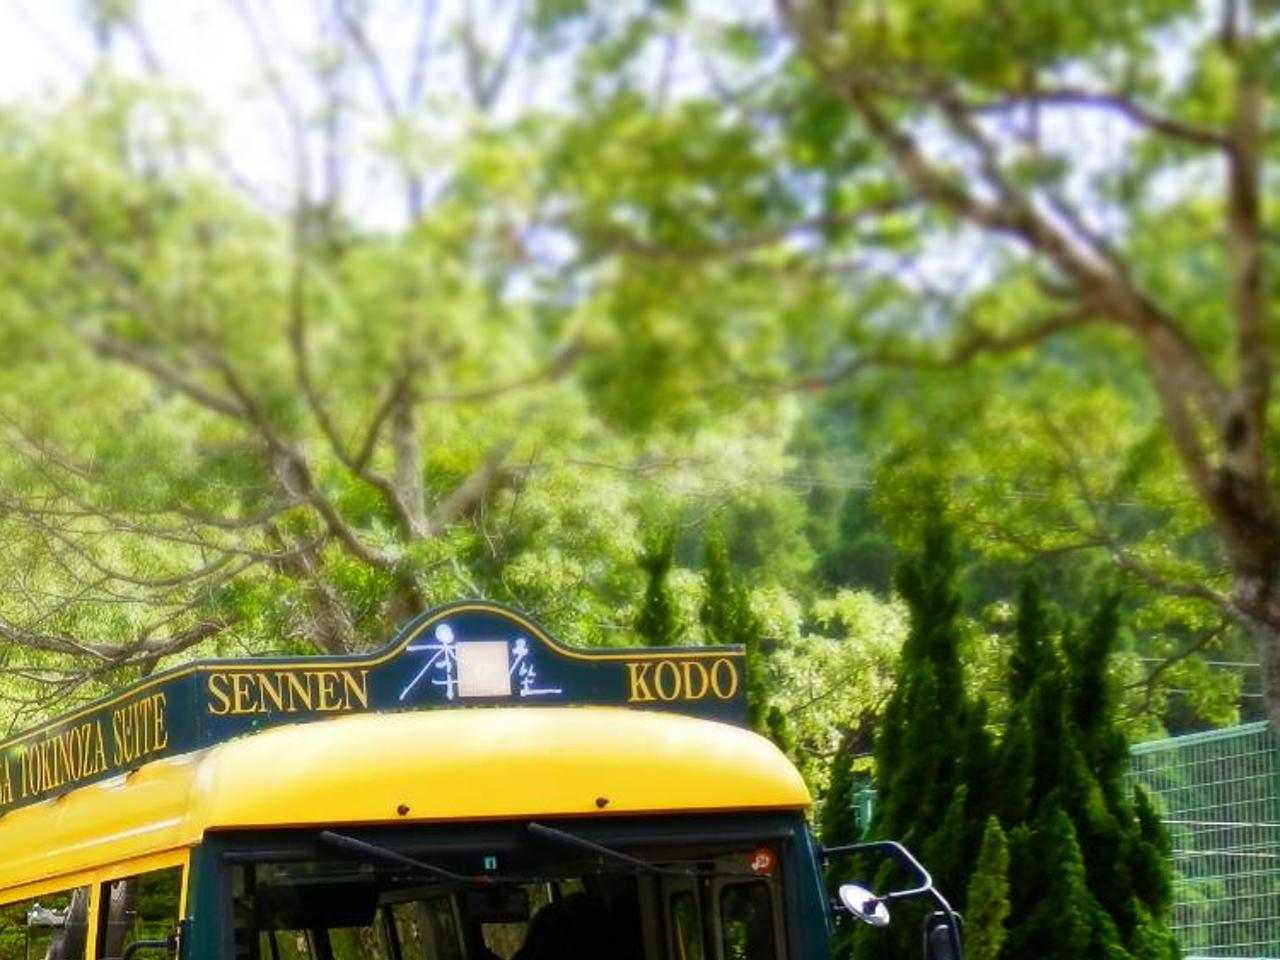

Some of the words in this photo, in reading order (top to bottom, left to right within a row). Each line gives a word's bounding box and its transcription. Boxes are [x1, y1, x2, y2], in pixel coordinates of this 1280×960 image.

[206, 669, 370, 716] SENNEN
[625, 658, 738, 702] KODO
[21, 719, 108, 797] TOKINOZA
[112, 692, 168, 766] SUITE
